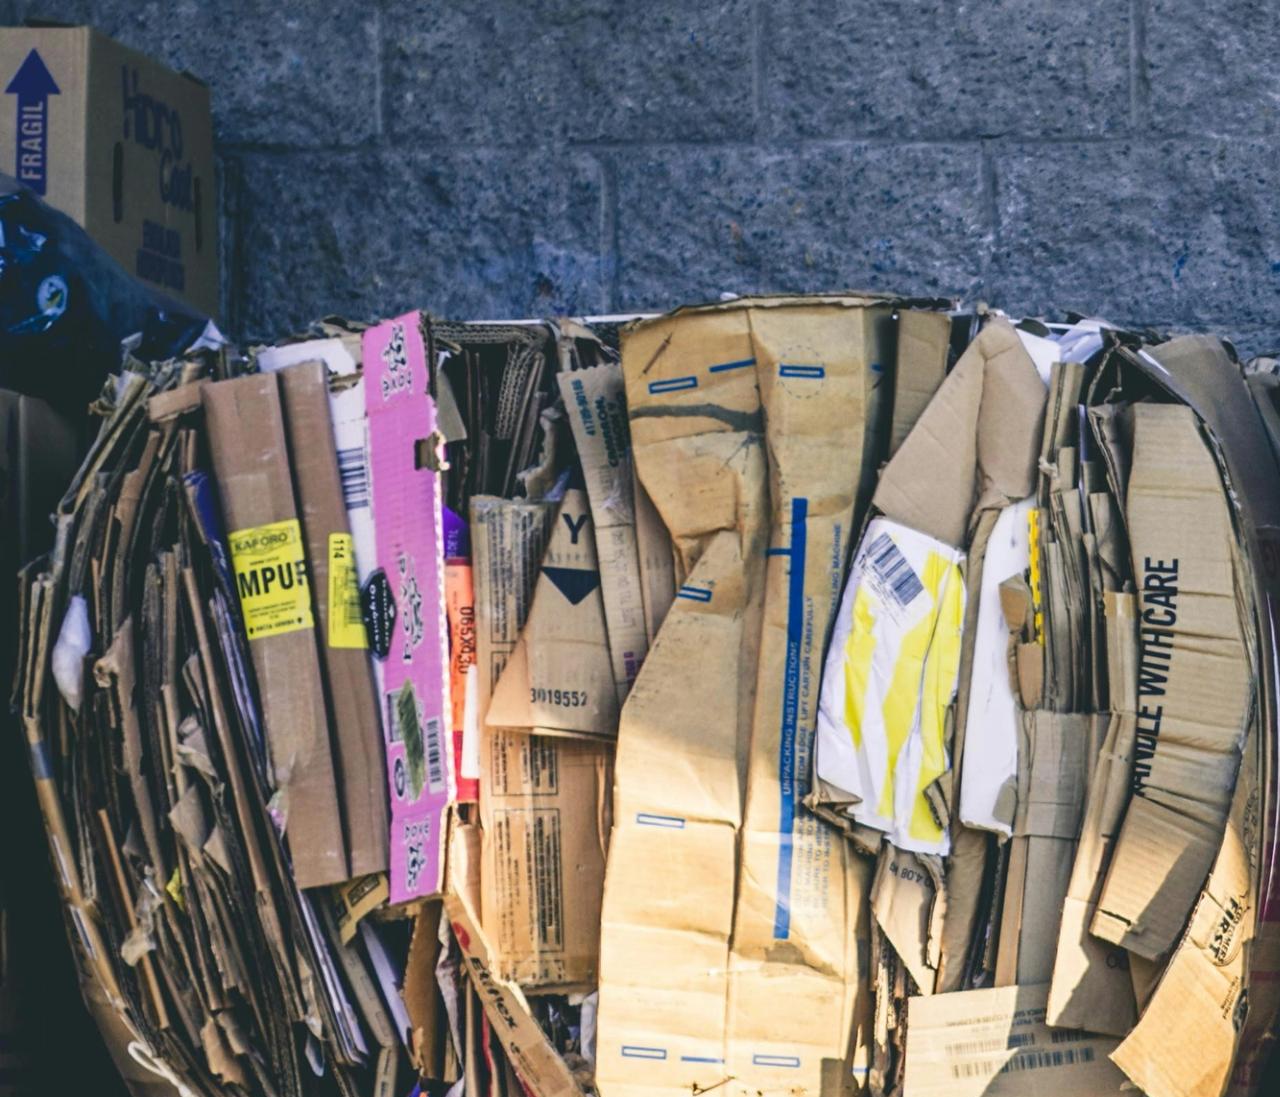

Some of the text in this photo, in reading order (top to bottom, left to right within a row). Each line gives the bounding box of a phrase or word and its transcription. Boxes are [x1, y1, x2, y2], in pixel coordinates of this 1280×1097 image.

[21, 101, 44, 180] FRAGIL
[779, 640, 798, 795] UNPACKING INSTRUCTIONS
[1208, 897, 1240, 957] FIRST
